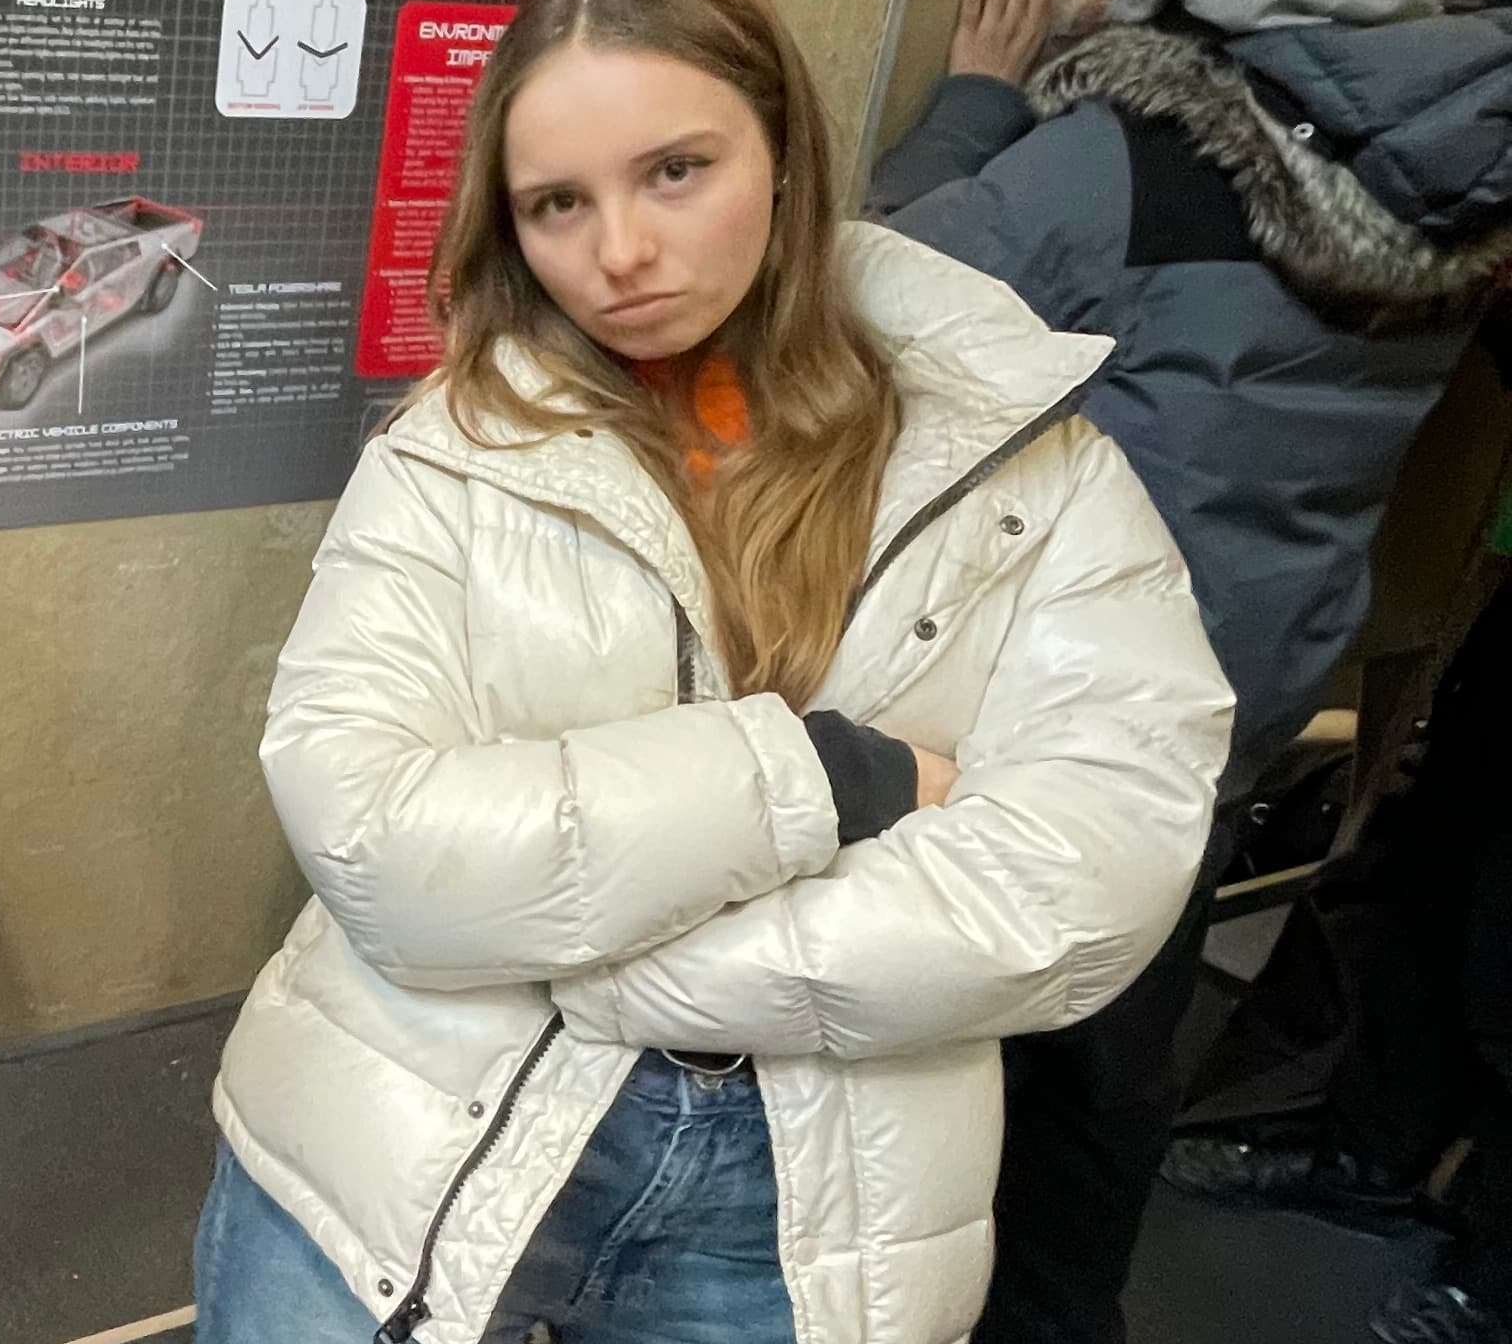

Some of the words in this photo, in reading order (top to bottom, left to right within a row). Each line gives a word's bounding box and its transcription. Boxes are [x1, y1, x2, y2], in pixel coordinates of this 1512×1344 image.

[419, 21, 509, 42] ENVRONM
[42, 424, 98, 438] VEHICLE
[101, 419, 178, 435] COMPONENTS
